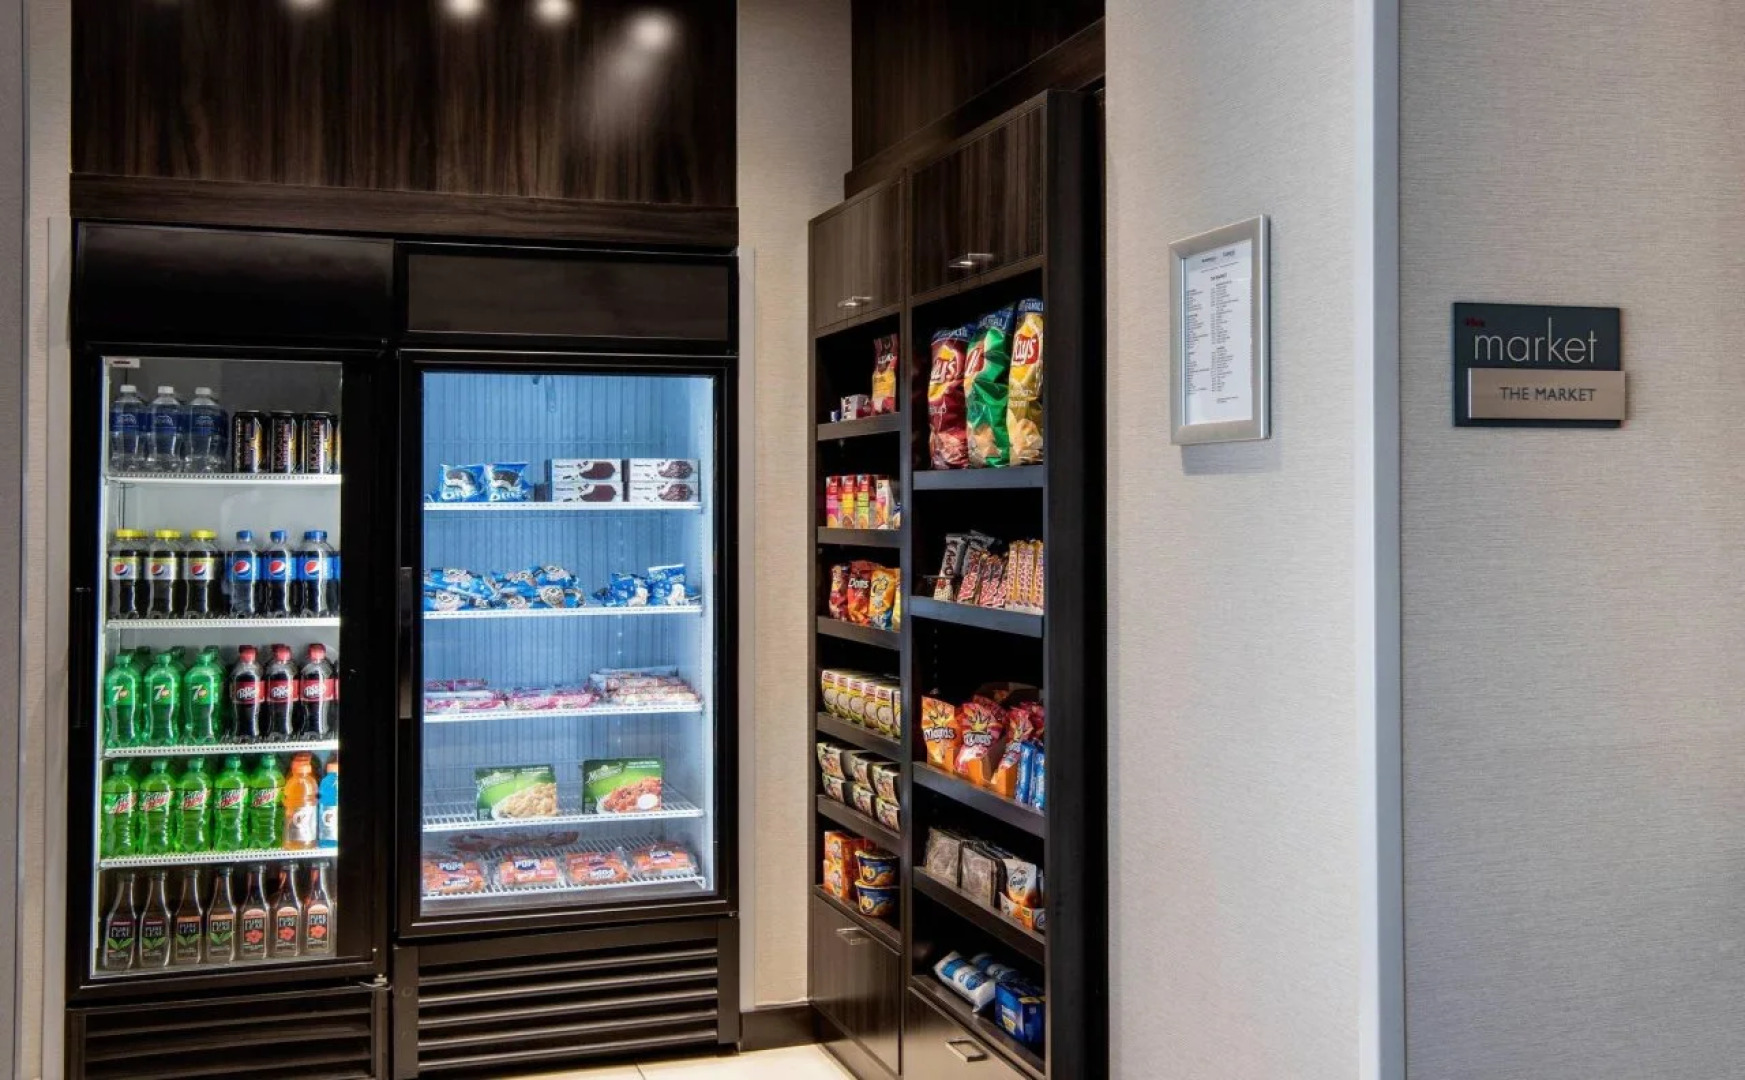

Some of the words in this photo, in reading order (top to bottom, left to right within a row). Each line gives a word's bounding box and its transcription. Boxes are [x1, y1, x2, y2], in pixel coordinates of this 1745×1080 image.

[1474, 316, 1598, 364] market
[1499, 386, 1530, 401] THE
[1534, 387, 1597, 402] MARKET
